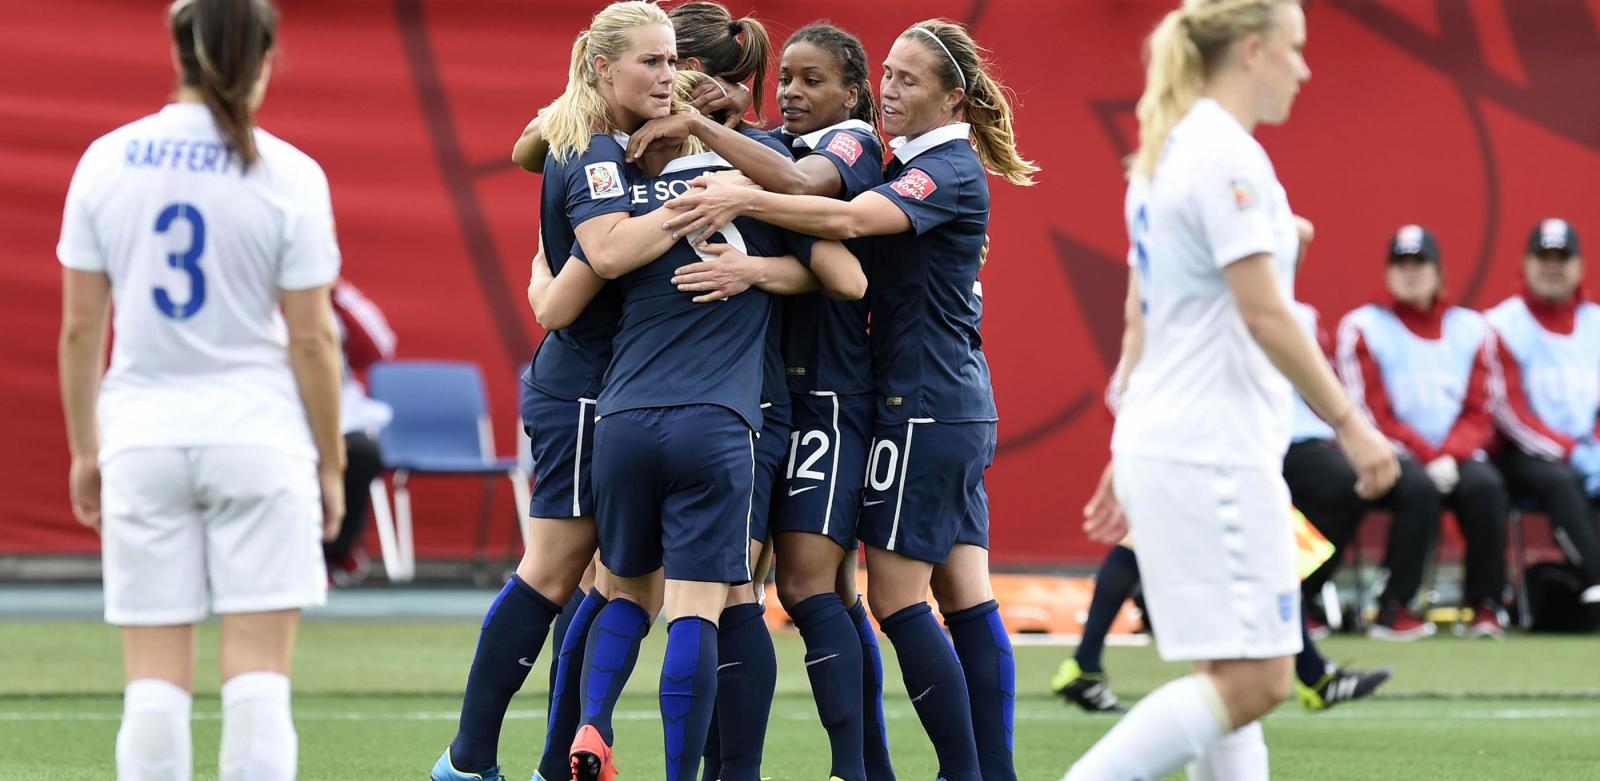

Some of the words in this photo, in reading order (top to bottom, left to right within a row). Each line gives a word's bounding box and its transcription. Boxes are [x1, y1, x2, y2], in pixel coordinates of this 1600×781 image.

[125, 139, 248, 177] RAFFERT
[629, 184, 648, 204] E
[153, 203, 206, 320] 3
[786, 430, 830, 481] 12
